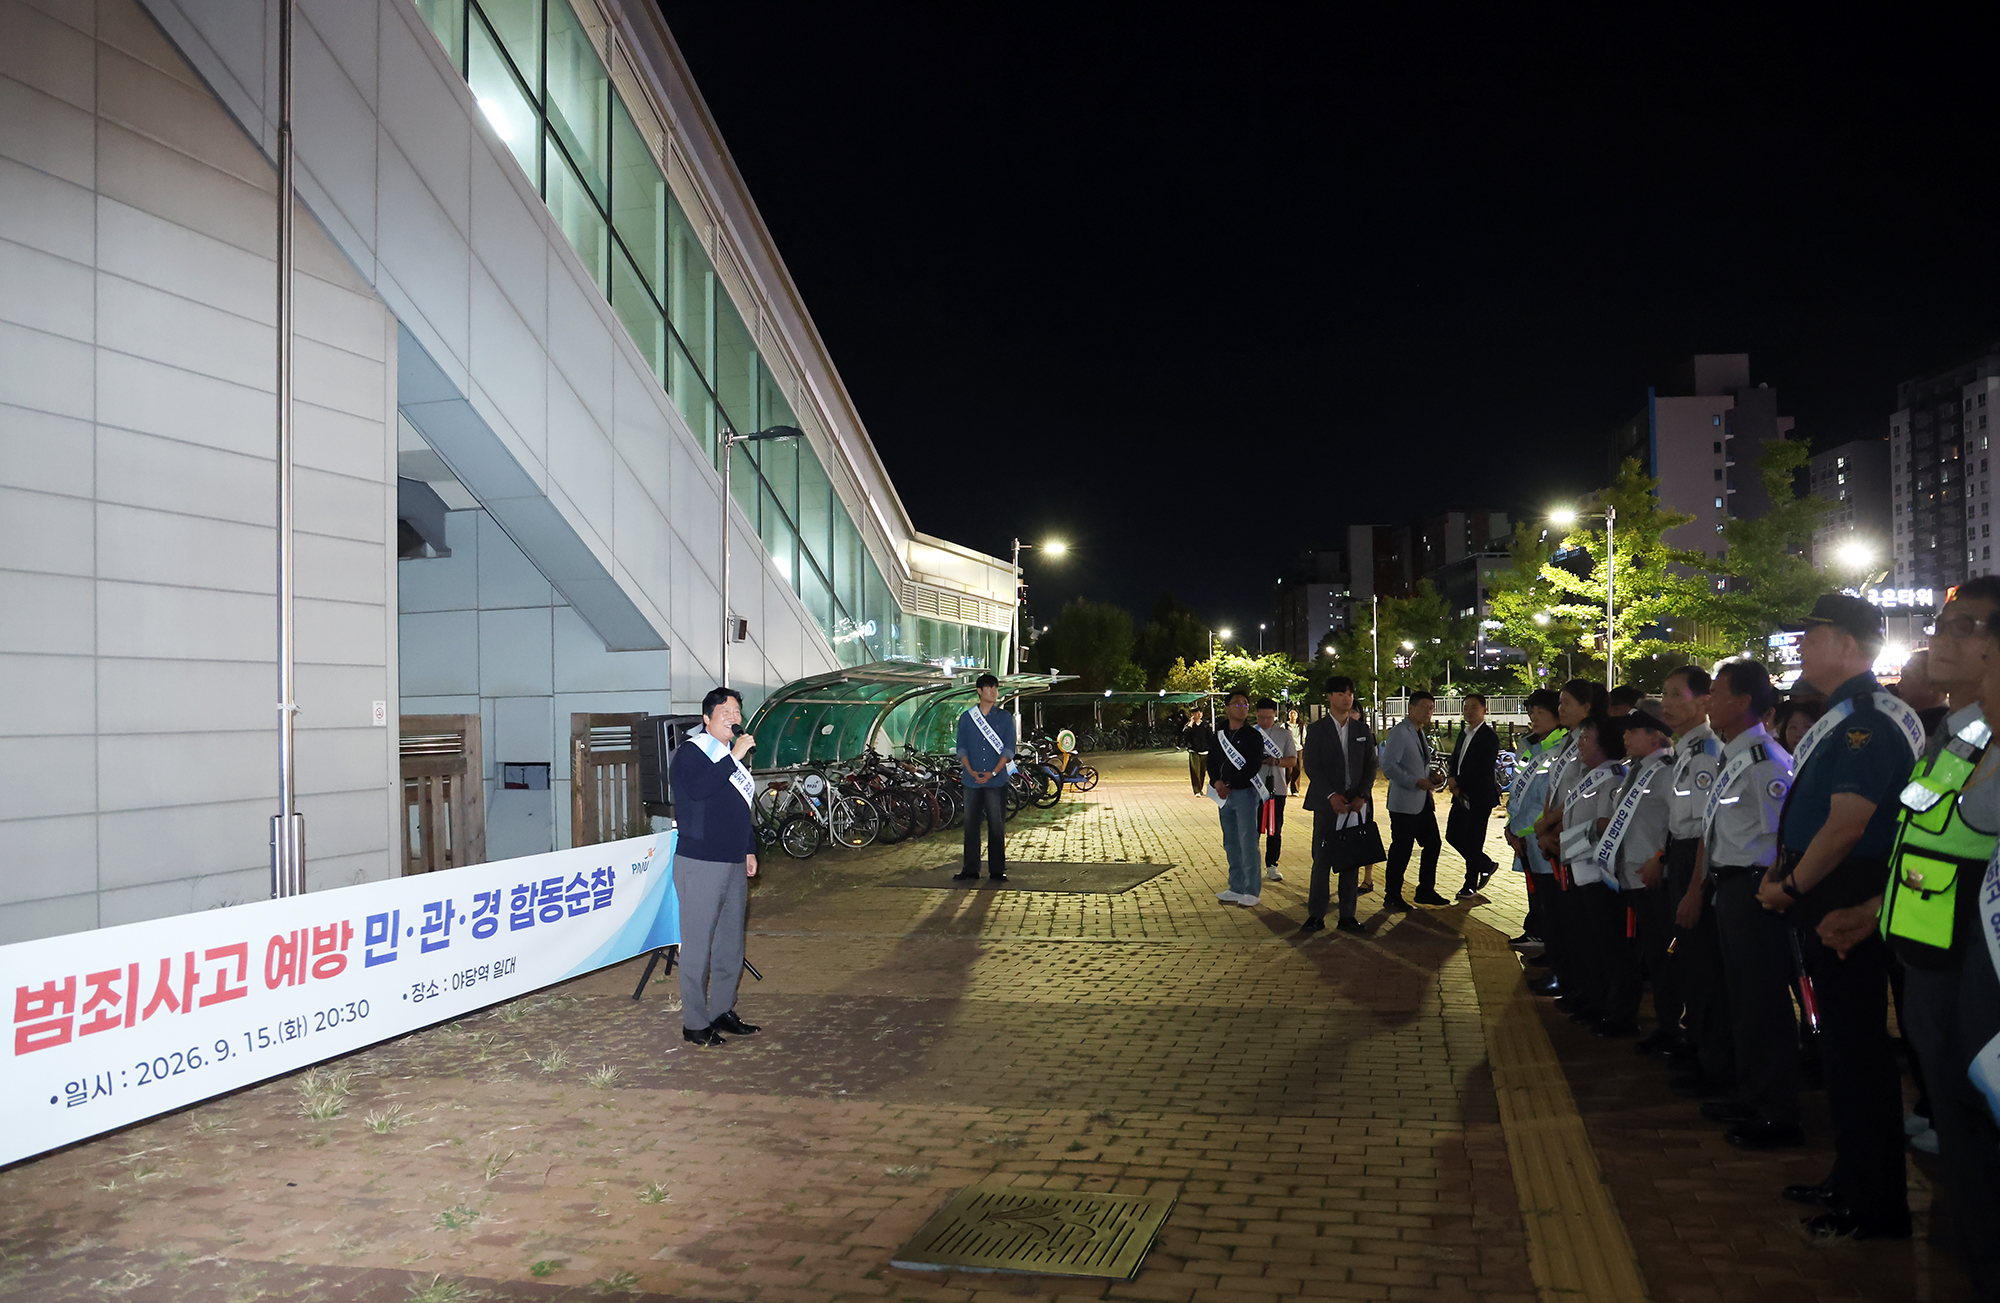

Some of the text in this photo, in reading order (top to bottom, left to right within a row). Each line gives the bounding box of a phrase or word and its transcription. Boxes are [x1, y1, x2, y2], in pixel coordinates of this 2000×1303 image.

[13, 866, 616, 1057] 범죄사고 예방 민·관·경 합동순찰
[411, 980, 440, 1003] 장소
[452, 964, 490, 991] 야당역
[493, 956, 517, 982] 일대
[64, 1072, 113, 1109] 일시
[134, 1046, 209, 1087] 2026.
[214, 1039, 236, 1062] 9.
[243, 1014, 309, 1053] 15.(화)
[314, 999, 370, 1037] 20:30
